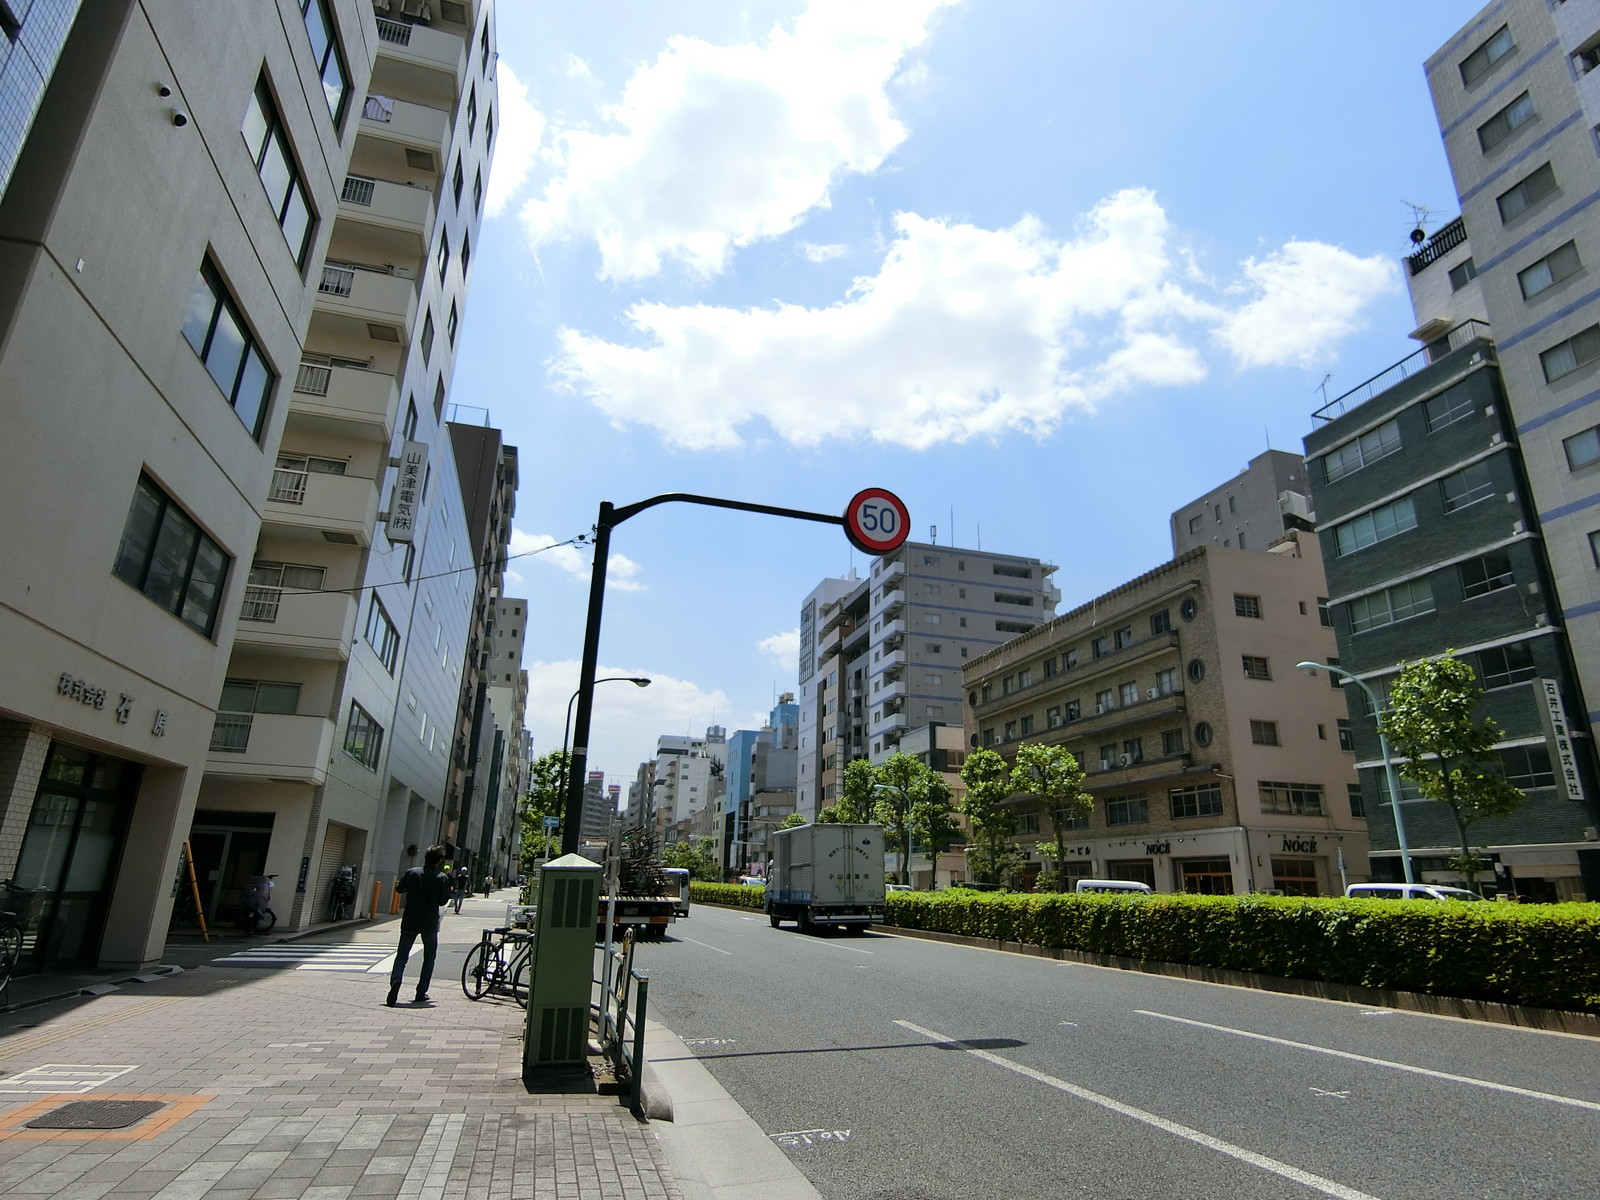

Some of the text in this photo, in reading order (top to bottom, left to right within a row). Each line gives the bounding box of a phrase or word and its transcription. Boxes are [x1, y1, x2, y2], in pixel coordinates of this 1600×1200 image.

[863, 504, 895, 533] 50
[57, 672, 106, 710] 株式会社
[1545, 683, 1580, 796] 石井工業株式会社
[1146, 843, 1171, 855] NOCE
[1282, 839, 1318, 853] NOCE
